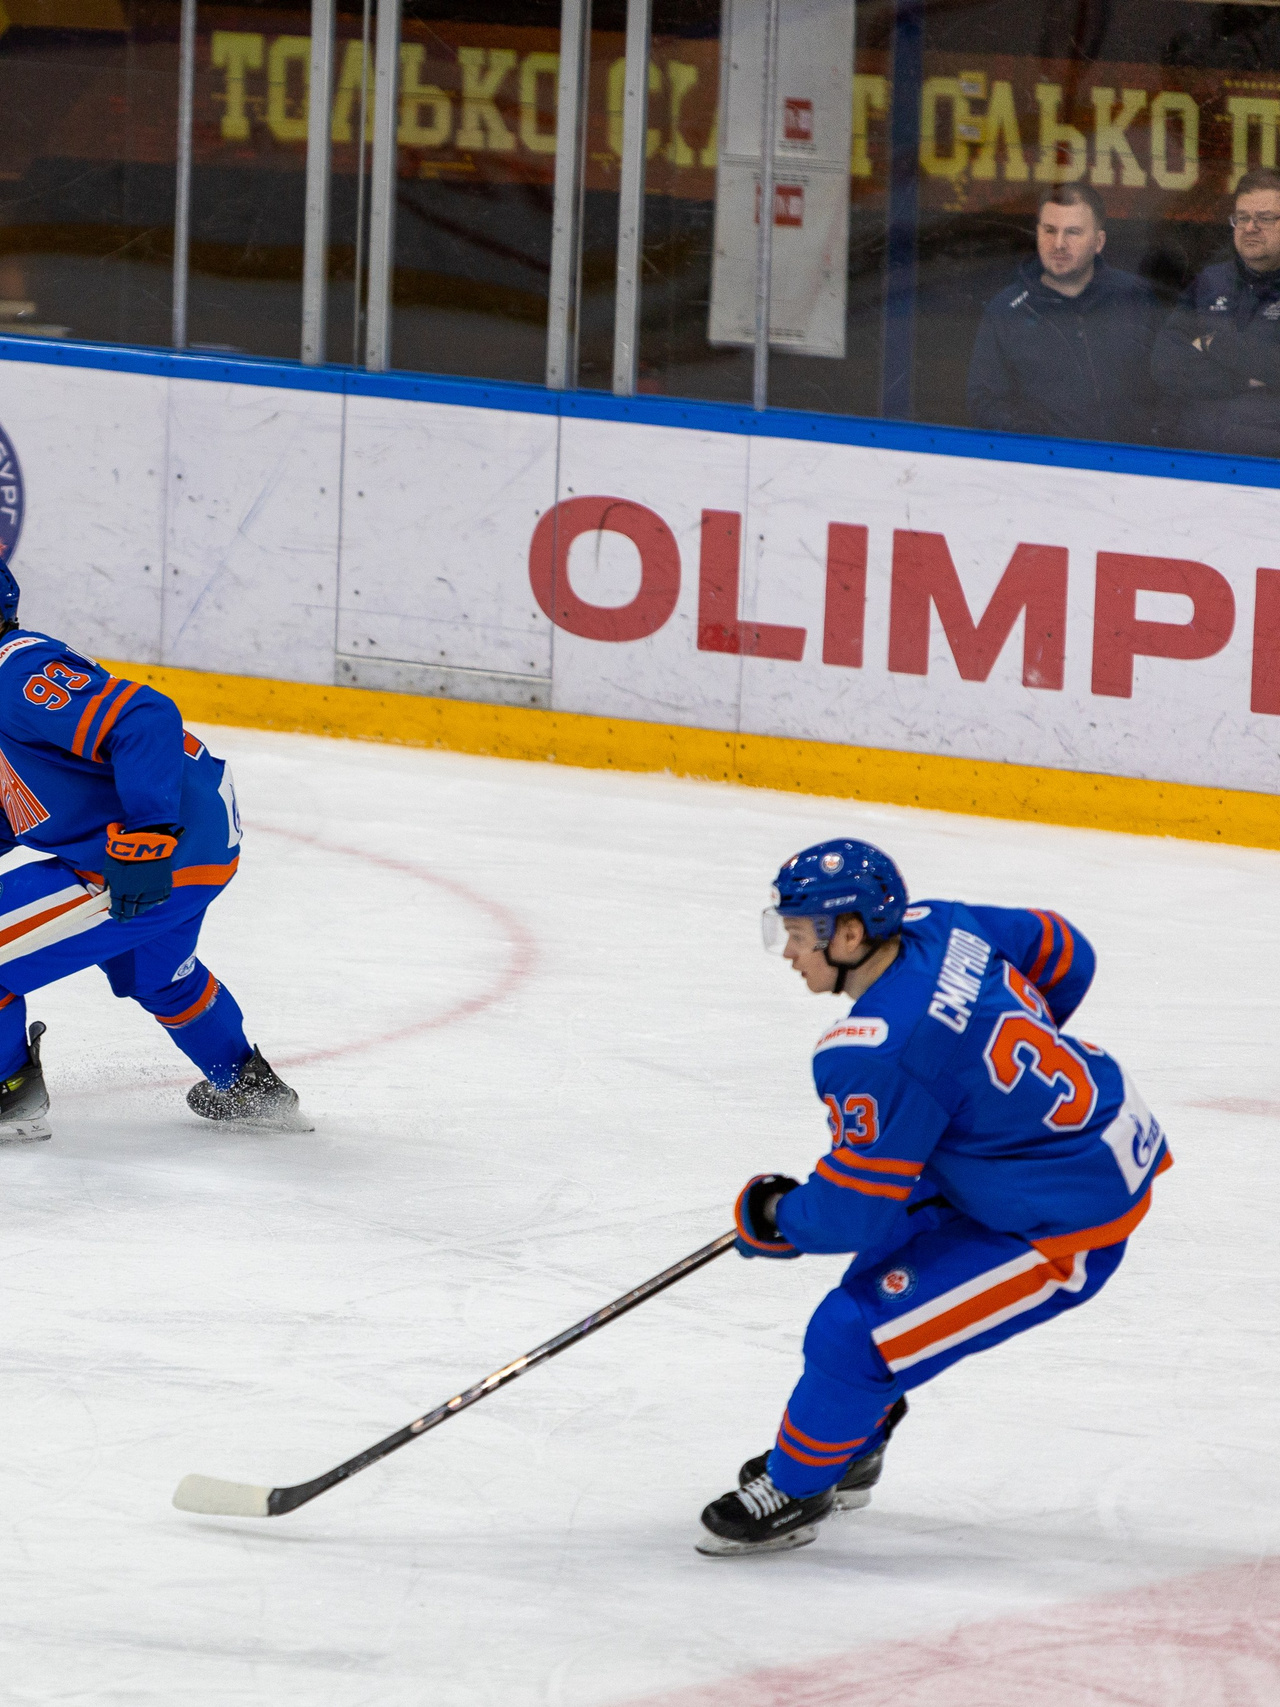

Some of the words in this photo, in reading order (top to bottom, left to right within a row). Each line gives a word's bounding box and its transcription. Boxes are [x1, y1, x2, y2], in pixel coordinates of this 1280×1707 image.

[528, 494, 1280, 717] OLIMP
[22, 660, 91, 710] 93
[106, 840, 167, 858] CM
[927, 927, 992, 1034] СМИРНОВ
